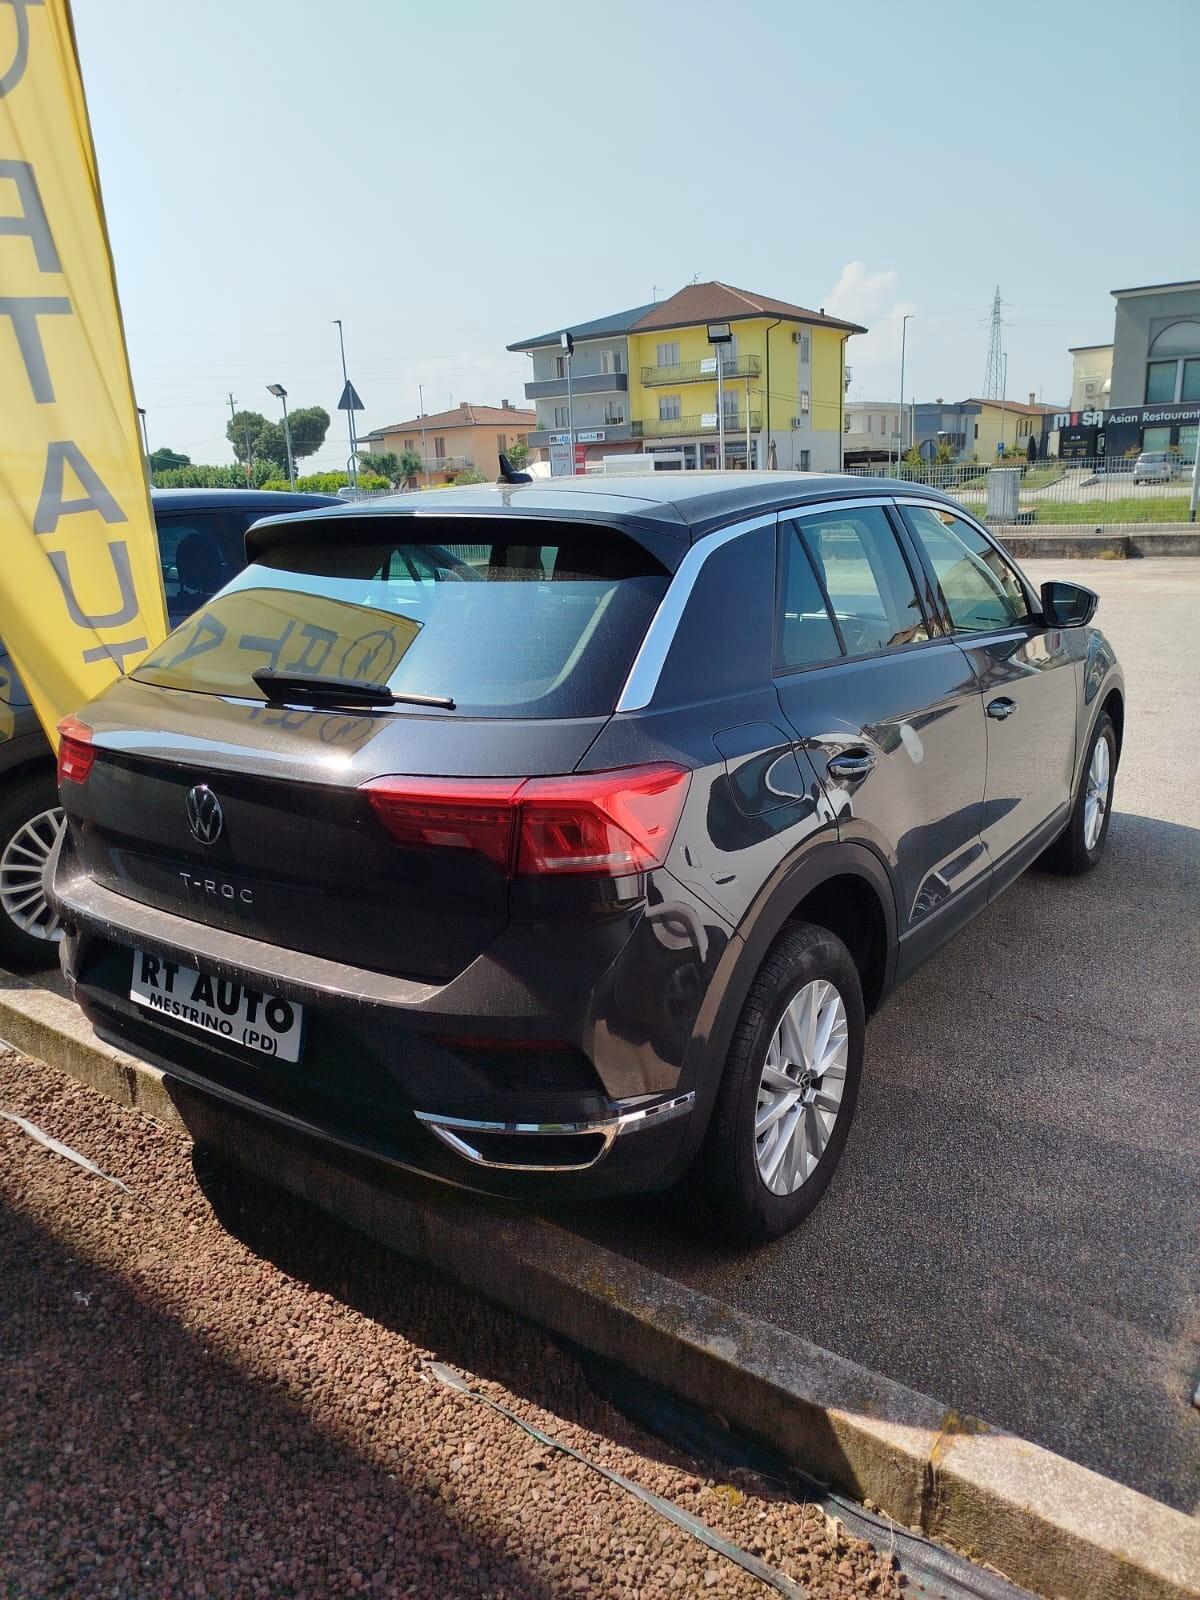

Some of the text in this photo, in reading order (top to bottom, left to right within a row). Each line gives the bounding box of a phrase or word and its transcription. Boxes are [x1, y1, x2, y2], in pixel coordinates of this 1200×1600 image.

[1108, 413, 1138, 424] Asian
[179, 872, 254, 904] T-ROC
[141, 952, 294, 1034] RT AUTO
[149, 992, 278, 1057] MESTRINO (PD)
